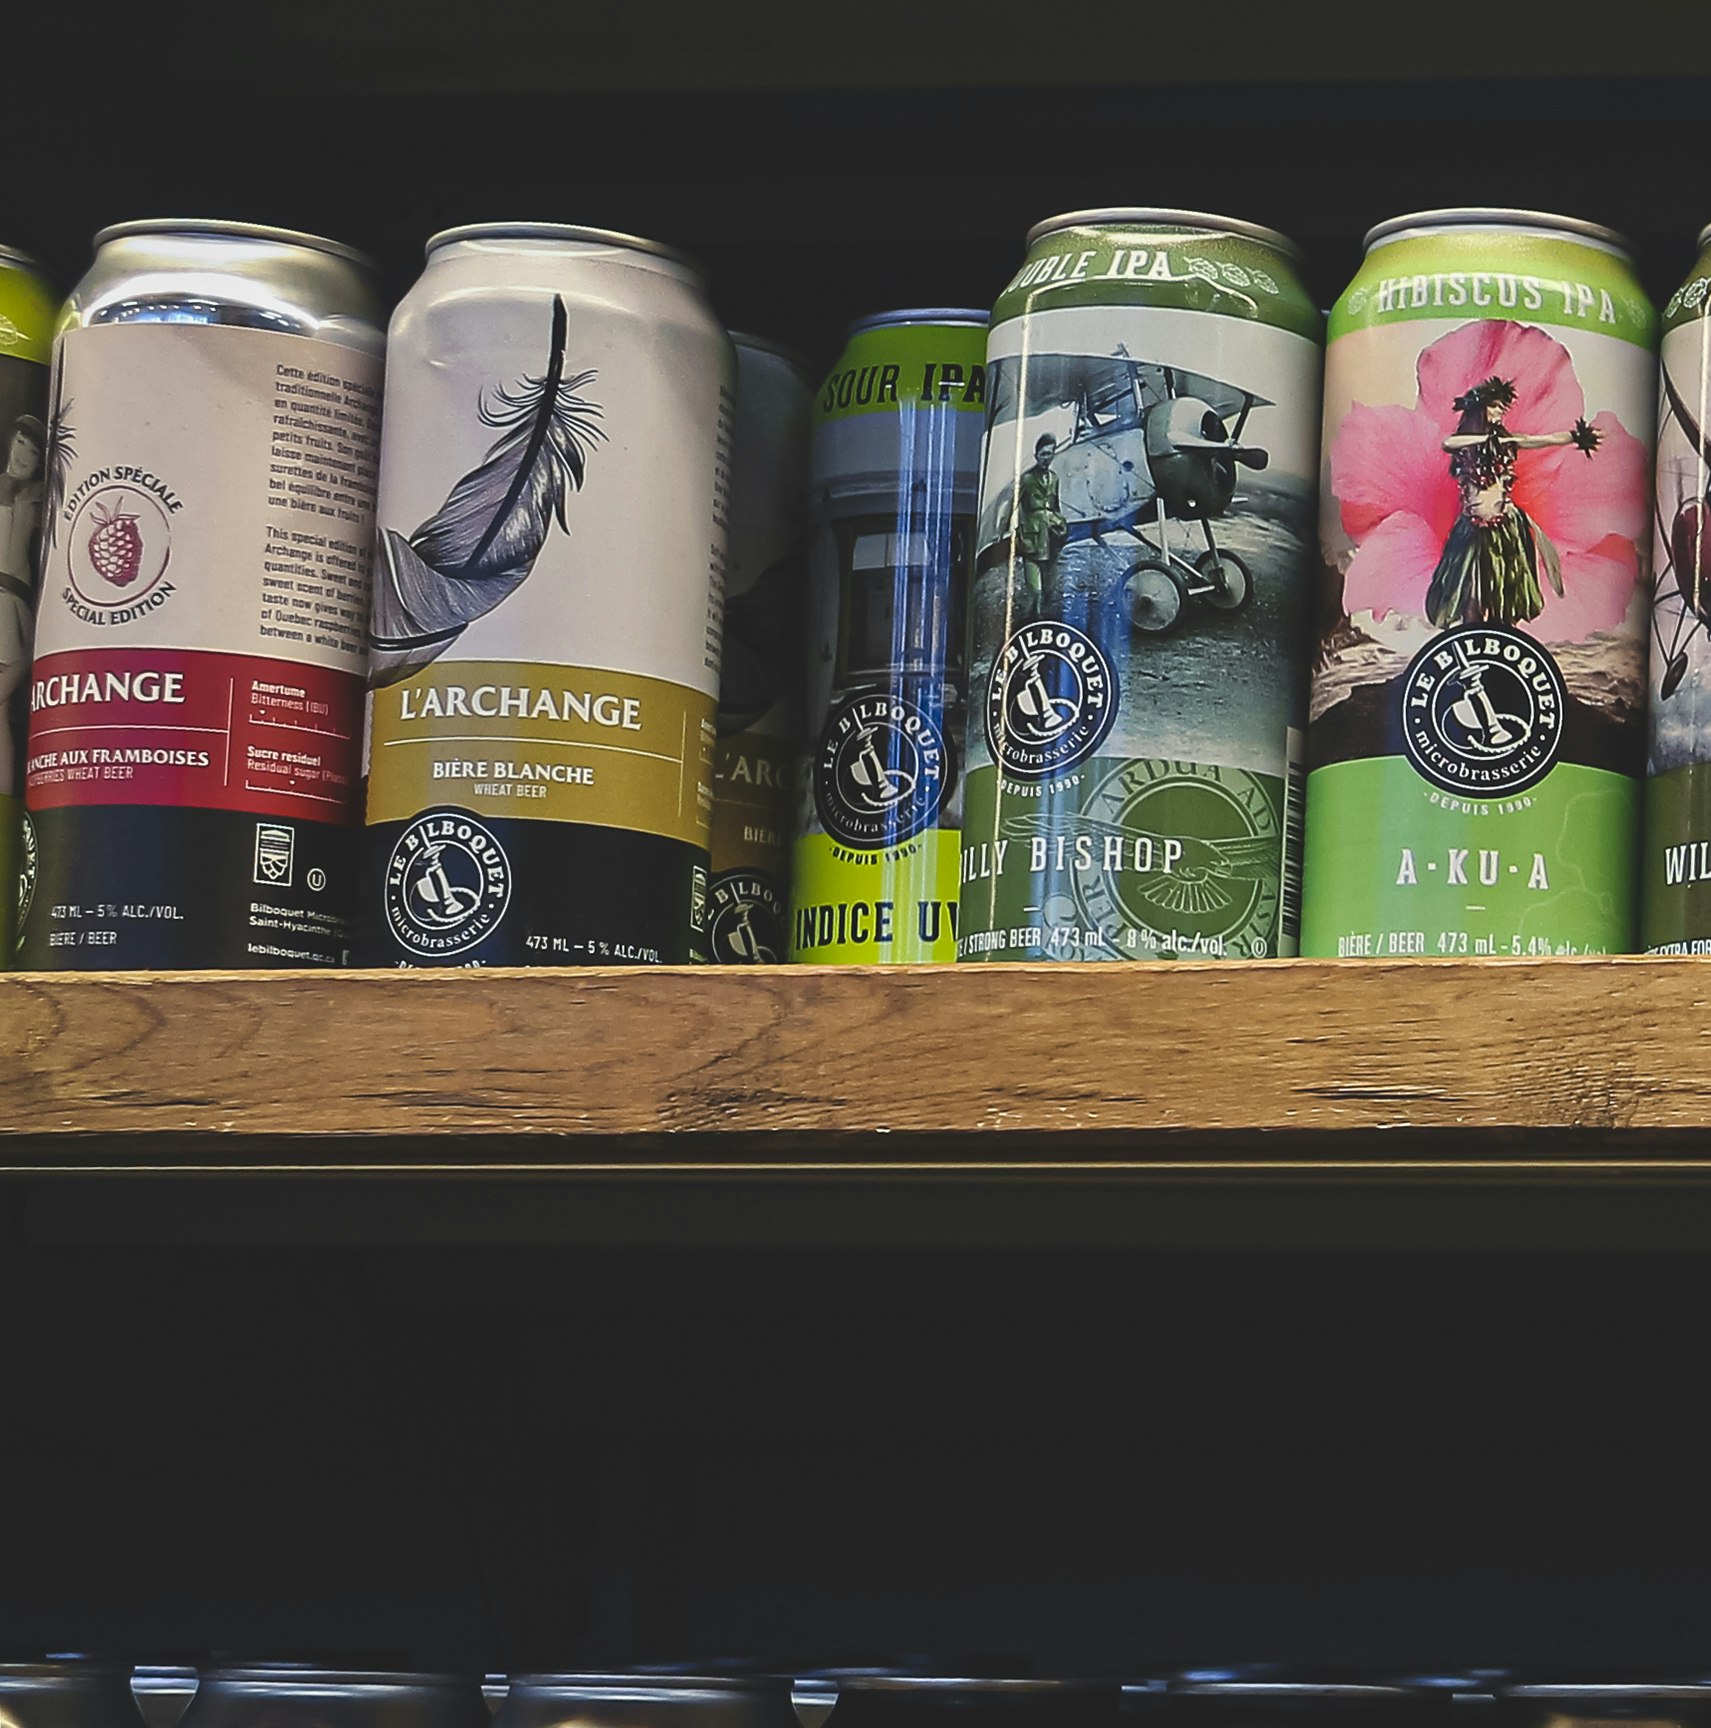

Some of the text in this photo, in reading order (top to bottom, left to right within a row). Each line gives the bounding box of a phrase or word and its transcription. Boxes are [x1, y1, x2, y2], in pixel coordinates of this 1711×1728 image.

[1107, 249, 1171, 279] IPA
[1377, 275, 1618, 324] HIBISCUS IPA
[822, 368, 901, 413] SOUR
[64, 465, 185, 522] ÉDITION SPÉCIALE
[61, 580, 177, 626] SPECIAL EDITION
[251, 681, 307, 698] Amertume
[400, 686, 643, 731] L'ARCHANGE
[92, 749, 210, 767] FRAMBOISES
[432, 758, 595, 785] BIÈRE BLANCHE
[474, 782, 548, 799] WHEAT BEER
[1430, 791, 1490, 817] DEPUIS
[1030, 835, 1185, 874] BISHOP
[795, 899, 894, 950] INDICE
[525, 935, 570, 953] 473 ML
[1388, 932, 1425, 954] BEER
